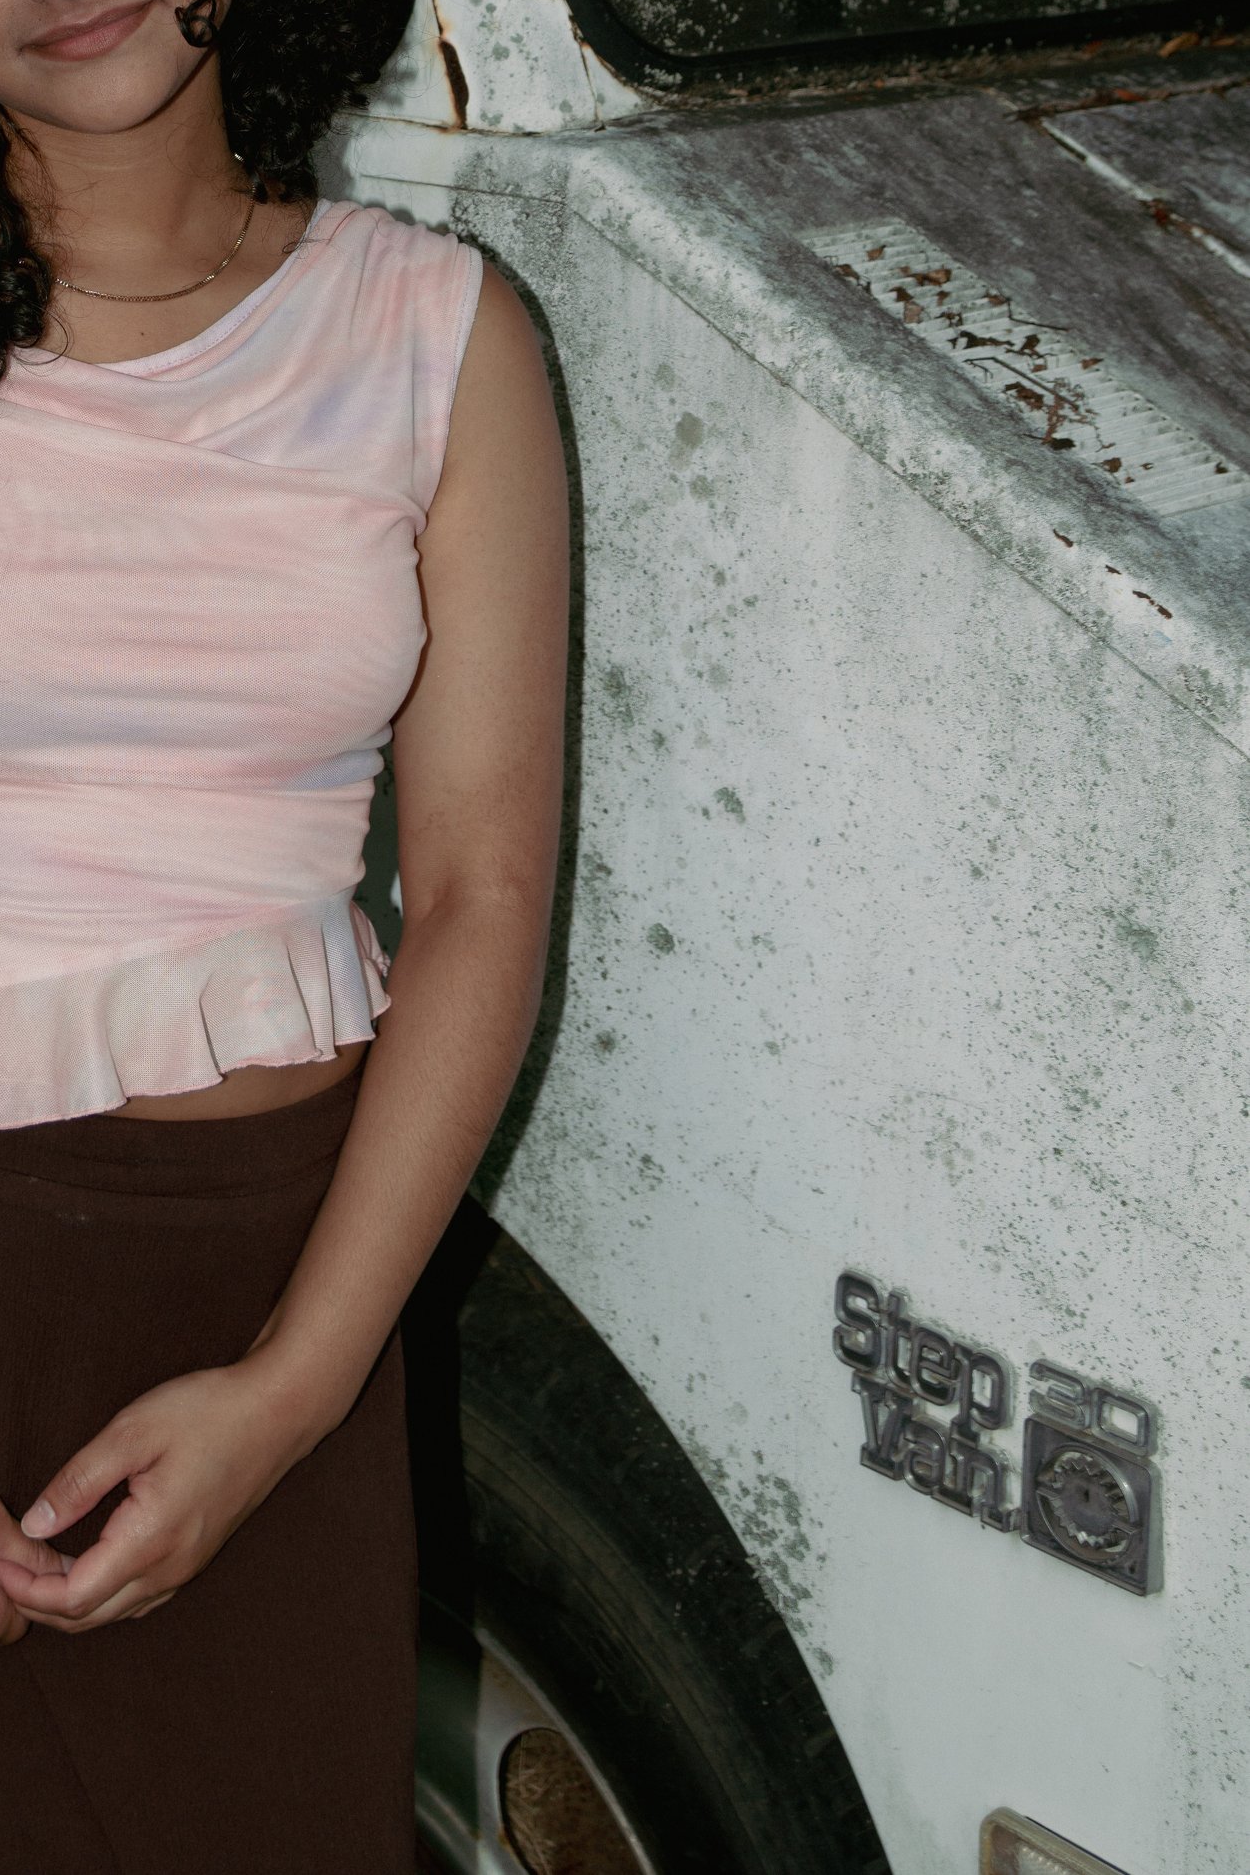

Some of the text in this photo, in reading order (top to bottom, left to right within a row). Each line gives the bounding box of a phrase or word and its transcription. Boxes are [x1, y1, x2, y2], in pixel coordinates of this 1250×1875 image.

[833, 1270, 1015, 1441] Step
[1029, 1359, 1157, 1457] 30
[851, 1371, 1019, 1533] Van
